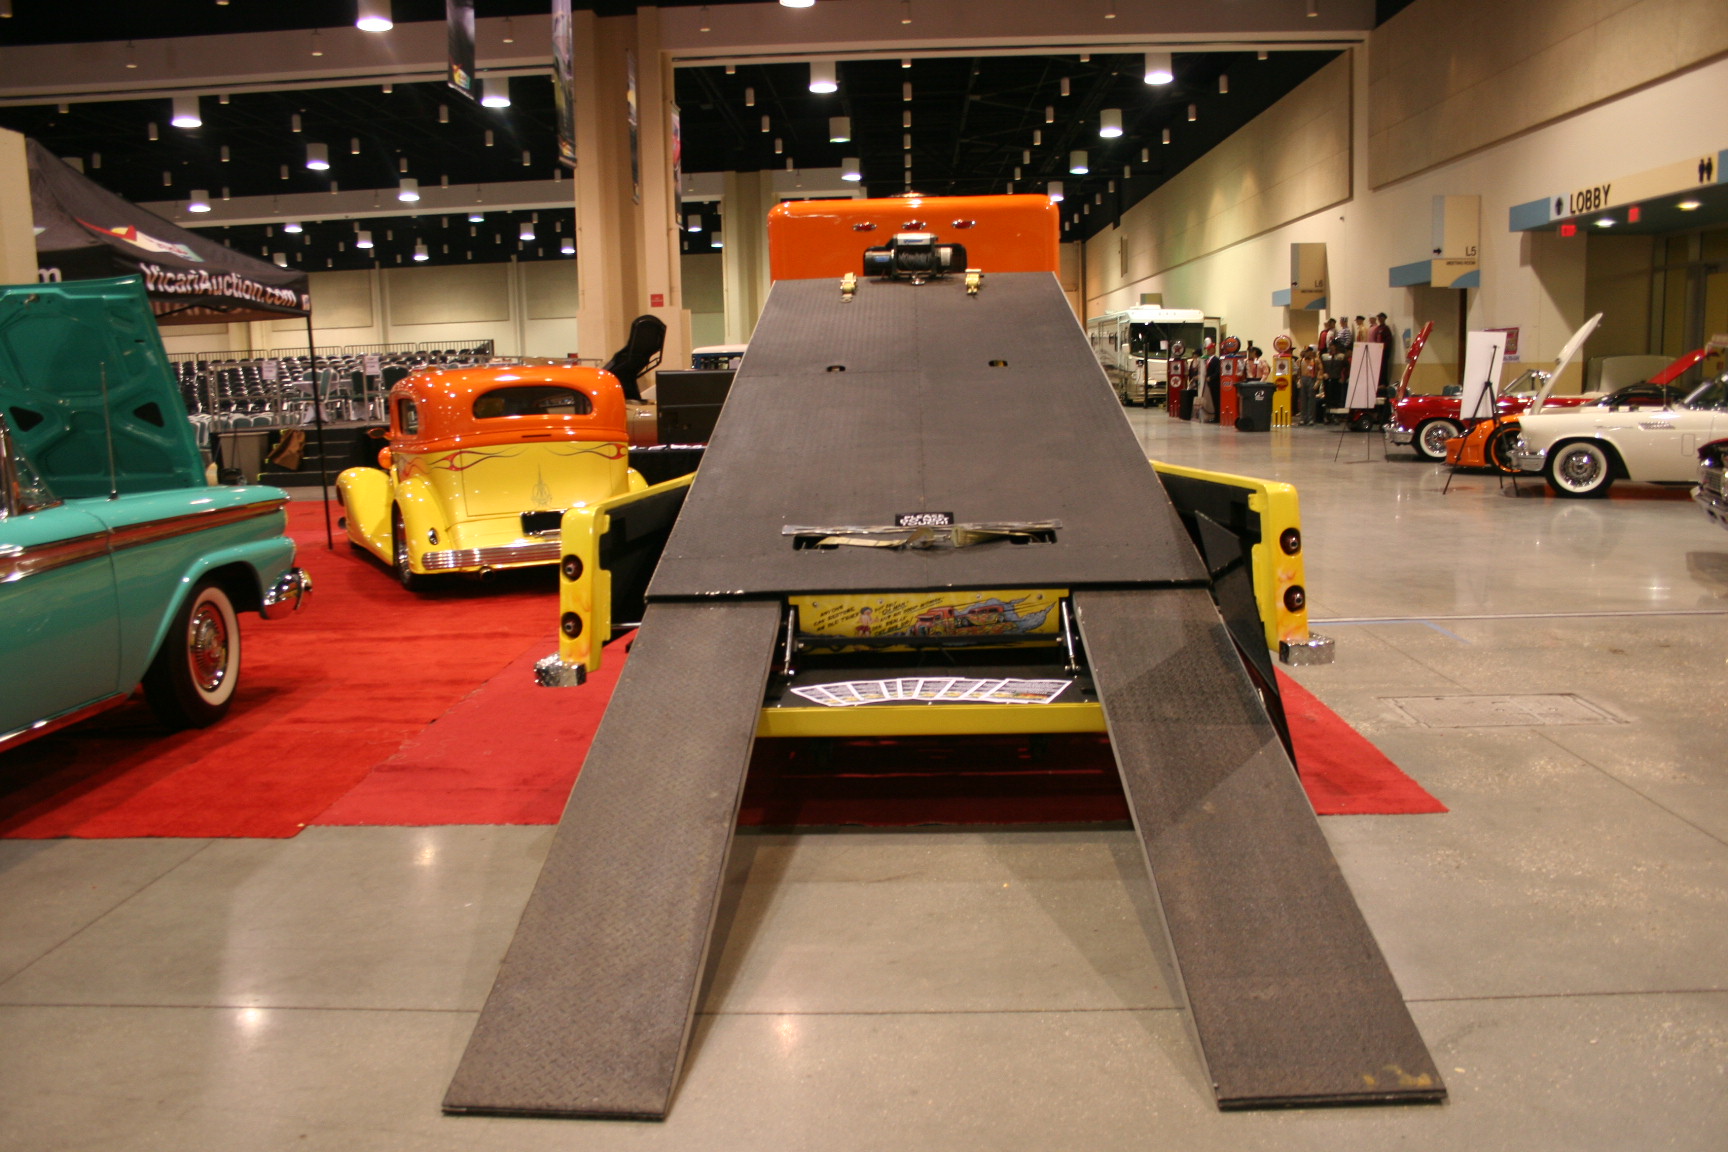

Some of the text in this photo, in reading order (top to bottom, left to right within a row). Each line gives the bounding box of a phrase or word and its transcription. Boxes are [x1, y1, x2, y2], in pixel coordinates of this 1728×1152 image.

[1569, 183, 1611, 214] LOBBY
[1465, 246, 1477, 257] L5
[138, 260, 298, 307] VicariAuction.com
